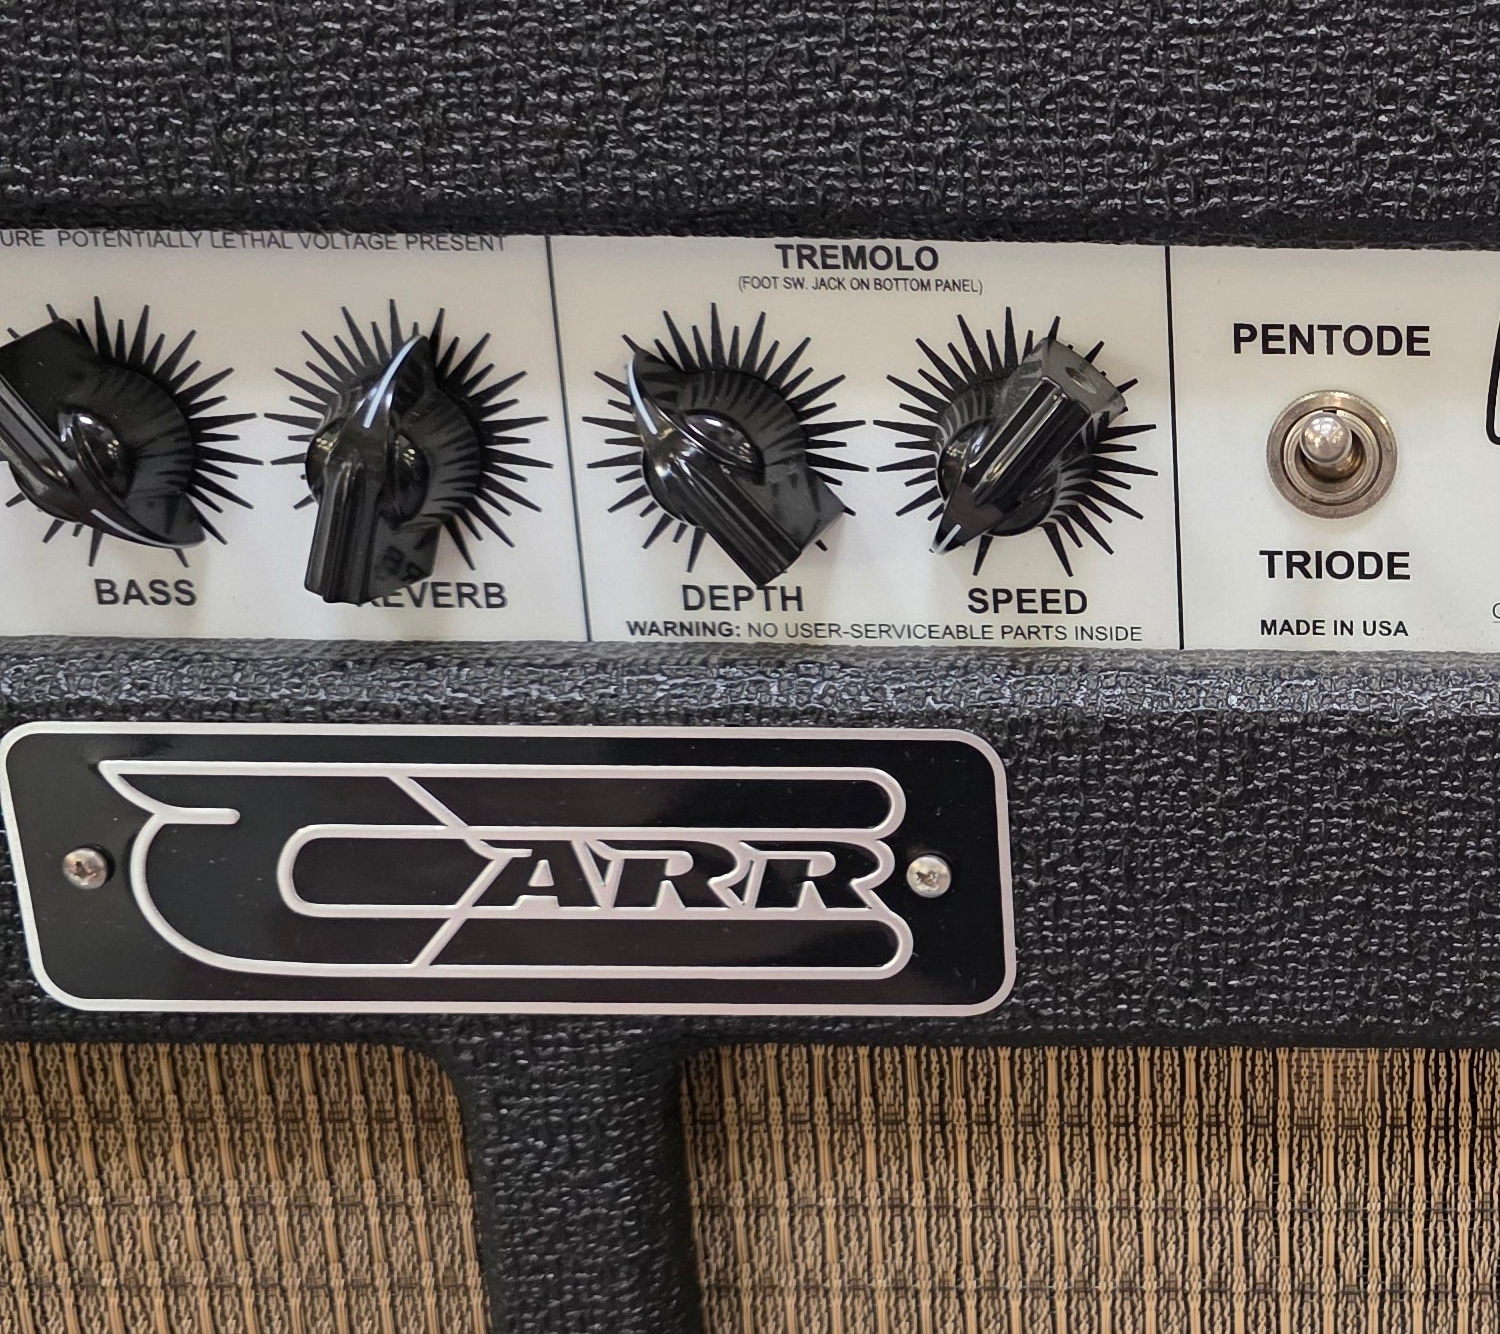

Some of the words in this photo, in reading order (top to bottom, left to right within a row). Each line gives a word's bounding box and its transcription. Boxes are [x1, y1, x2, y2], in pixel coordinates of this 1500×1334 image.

[57, 229, 203, 249] POTENTIALLY
[210, 231, 294, 250] LETHAL
[299, 232, 399, 251] VOLTAGE
[405, 234, 506, 253] PRESENT
[774, 243, 940, 272] TREMOLO
[738, 275, 780, 293] (FOOT
[783, 276, 809, 291] SW.
[812, 276, 847, 292] JACK
[850, 277, 871, 292] ON
[874, 277, 932, 293] BOTTOM
[935, 278, 984, 295] PANEL)
[1233, 322, 1431, 357] PENTODE
[1259, 550, 1411, 580] TRIODE
[94, 578, 198, 607] BASS
[371, 581, 508, 609] EVERB
[681, 583, 804, 612] DEPTH
[967, 587, 1088, 615] SPEED
[626, 620, 741, 638] WARNING:
[748, 622, 779, 638] NO
[785, 622, 994, 640] USER-SERVICEABLE
[1001, 624, 1068, 641] PARTS
[1074, 625, 1142, 642] INSIDE
[1260, 619, 1326, 636] MADE
[1333, 619, 1354, 636] IN
[1362, 620, 1409, 637] USA
[98, 759, 914, 981] CARR
